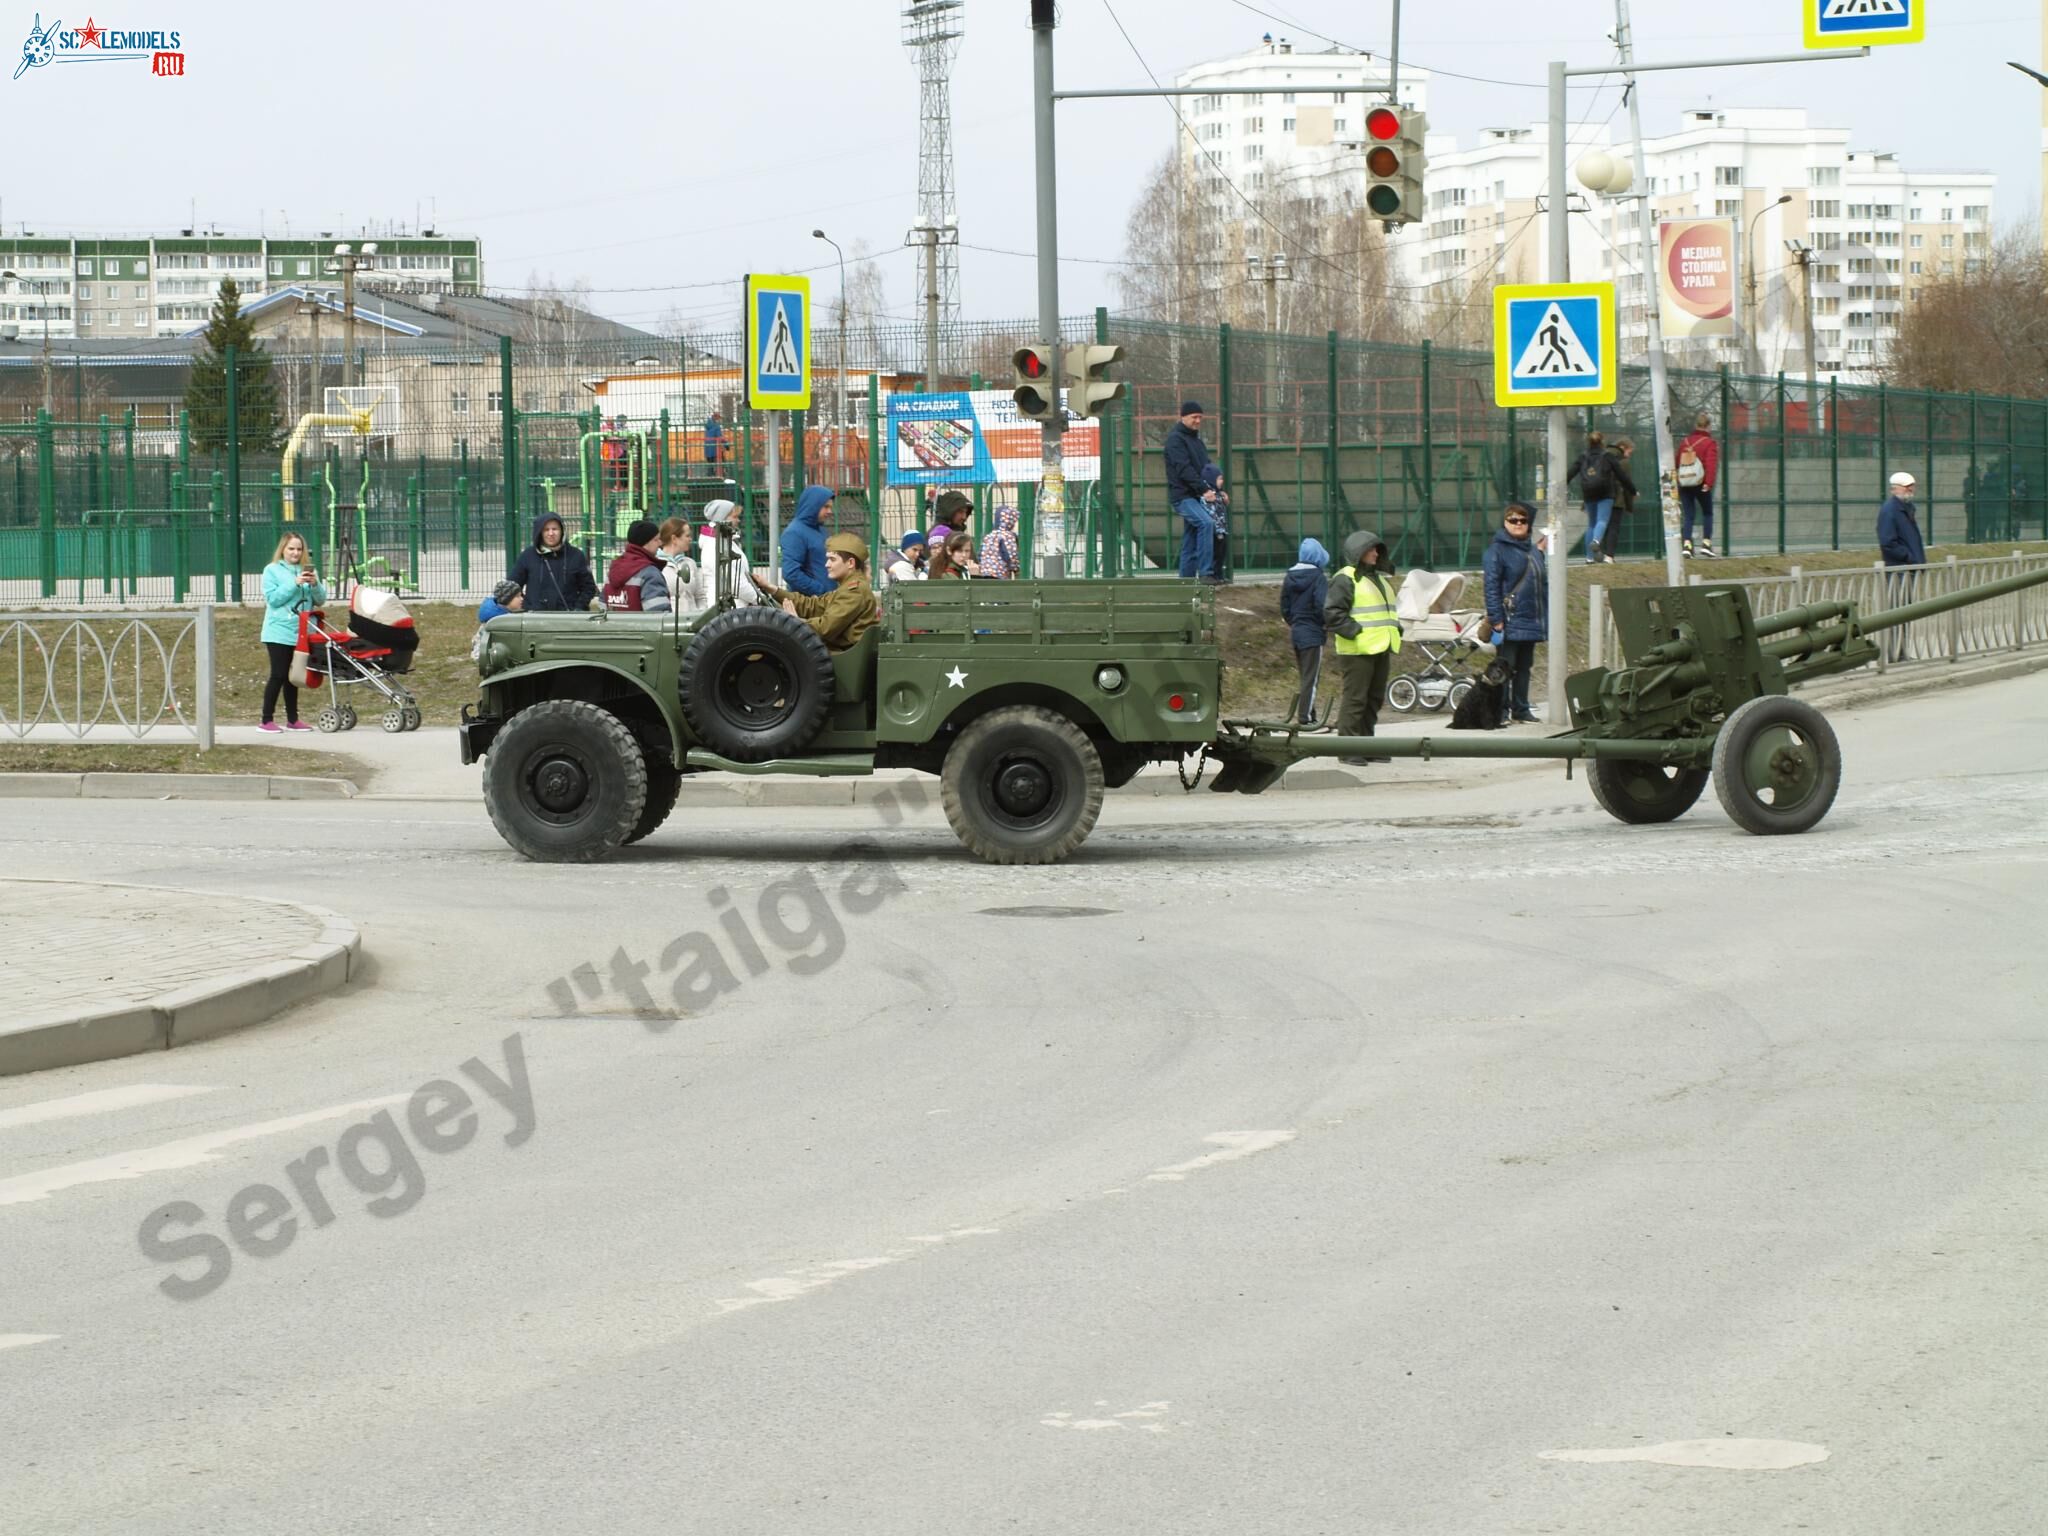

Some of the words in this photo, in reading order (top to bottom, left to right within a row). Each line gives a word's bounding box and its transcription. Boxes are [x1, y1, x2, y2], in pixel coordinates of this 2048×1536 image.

[1681, 246, 1722, 259] МЕДНАЯ
[1681, 260, 1727, 274] СТОЛИЦА
[1682, 275, 1716, 288] УРАЛА
